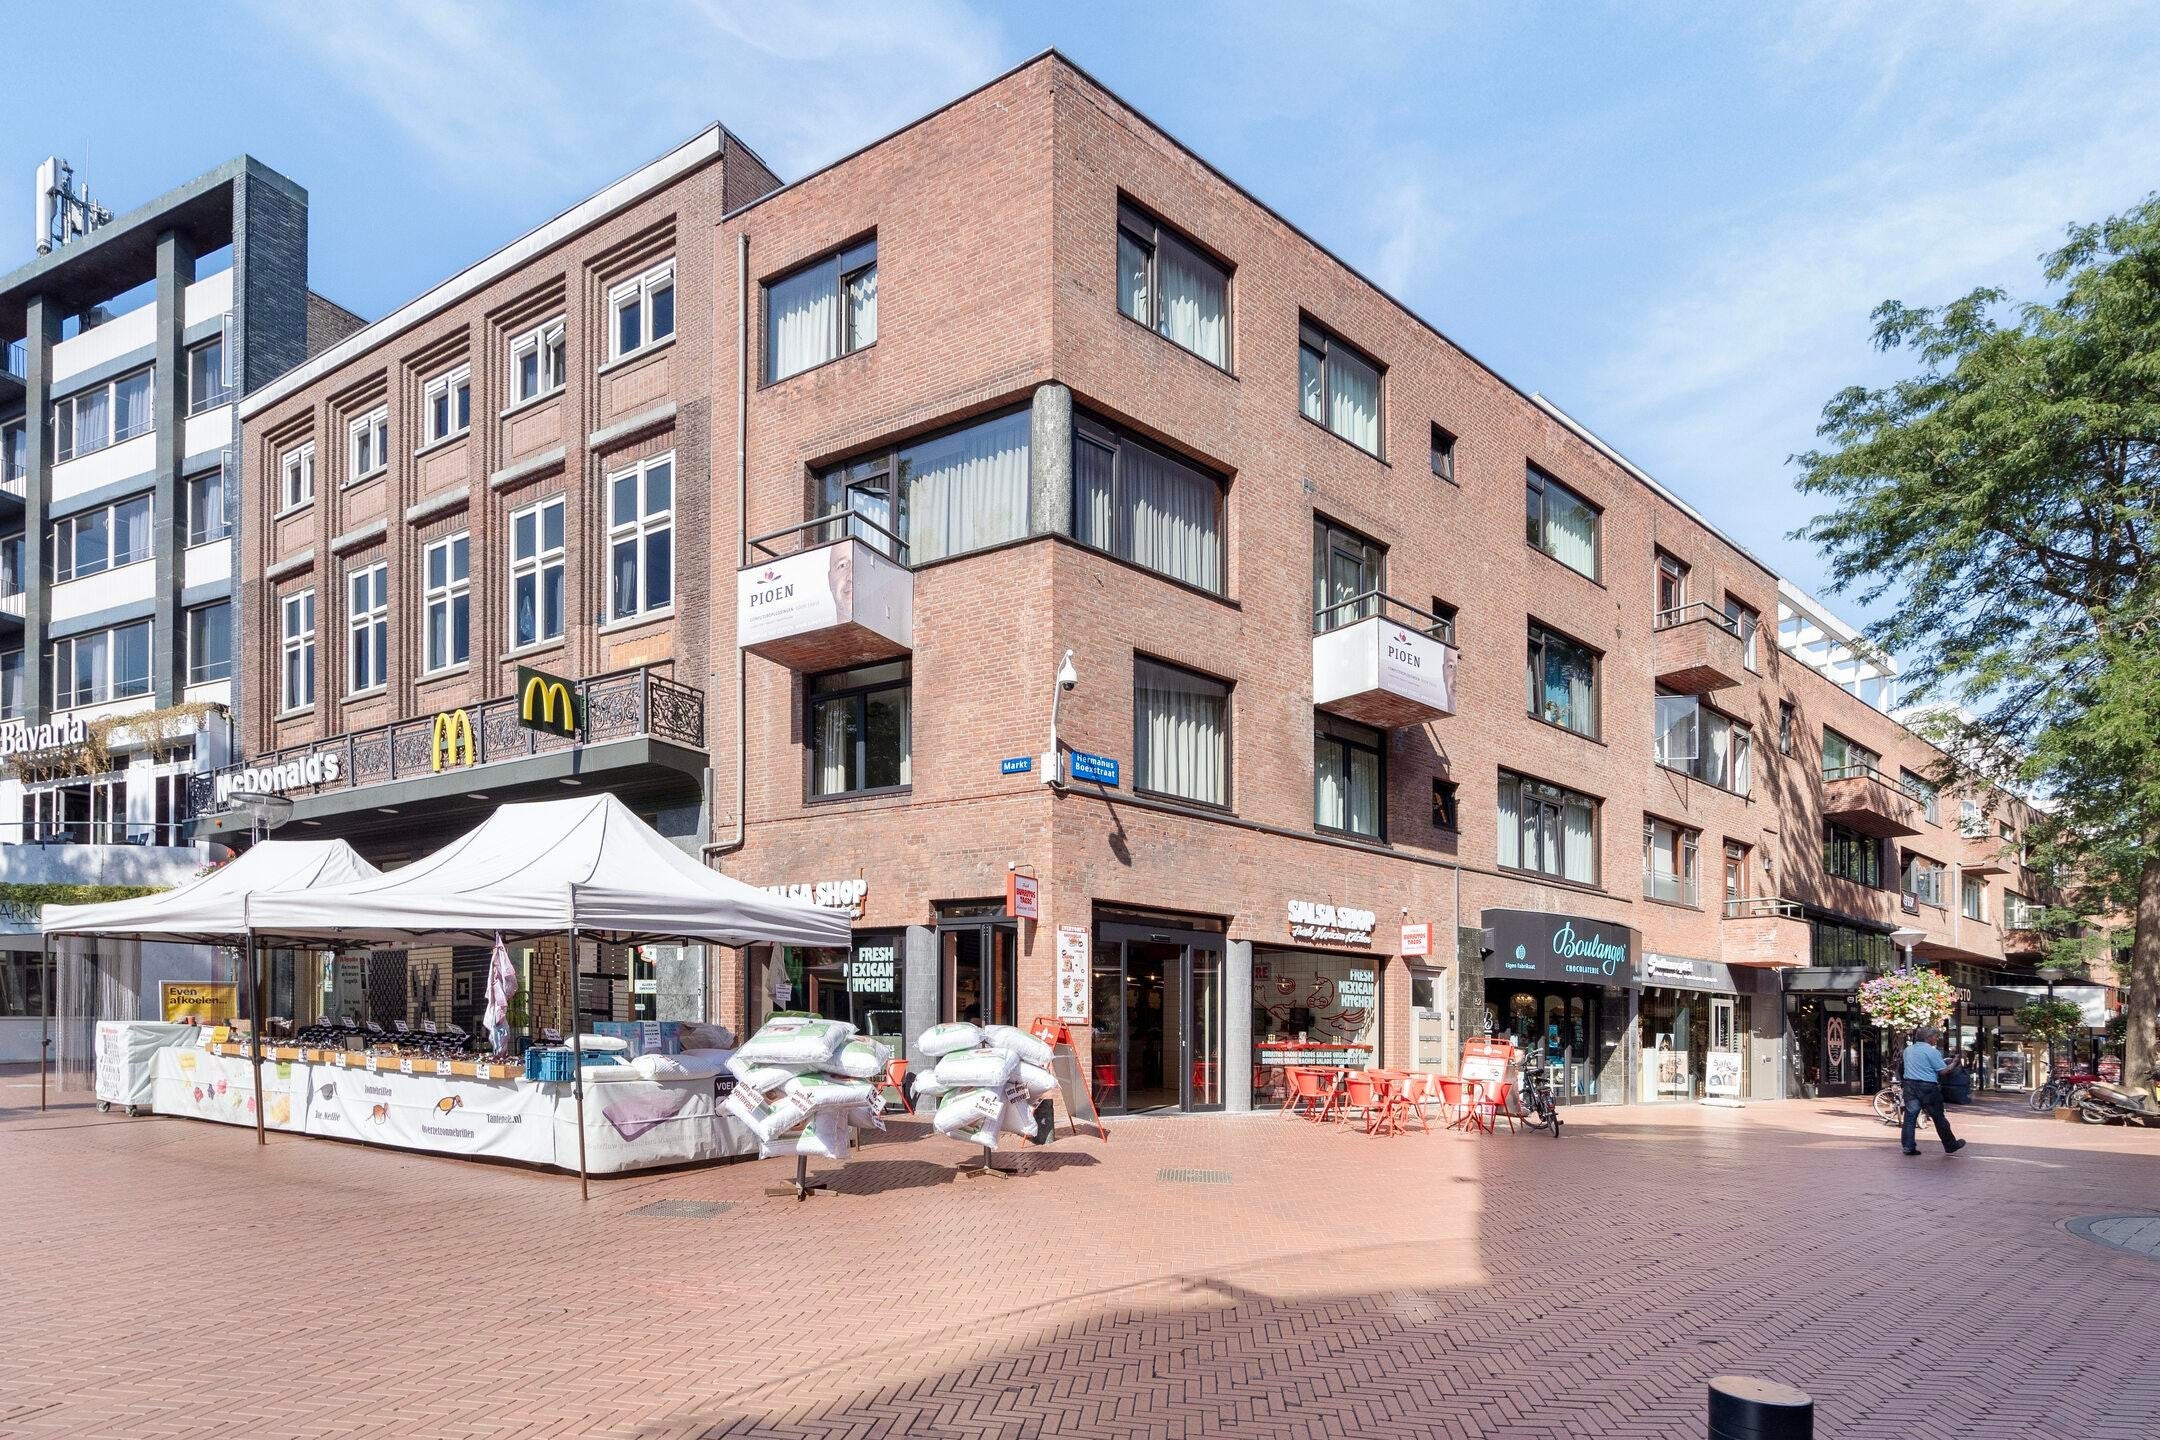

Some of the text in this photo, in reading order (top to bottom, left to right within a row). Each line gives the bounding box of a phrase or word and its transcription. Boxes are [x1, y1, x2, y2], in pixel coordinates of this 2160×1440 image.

[750, 584, 794, 607] PIOEN
[1388, 645, 1421, 668] PIOEN
[0, 713, 86, 756] Bavaria
[1003, 761, 1029, 771] Markt
[1076, 753, 1115, 769] Hermanus
[216, 753, 340, 803] McDonald's
[1075, 762, 1116, 778] Boexstraat
[815, 880, 868, 905] SHOP
[1288, 900, 1376, 932] SALSA SHOP
[859, 946, 894, 961] FRESH
[1553, 922, 1626, 975] Boulanger
[1350, 969, 1374, 981] FRESH
[1565, 965, 1600, 974] CHOCOLATERIE
[169, 987, 198, 996] Even
[1339, 980, 1374, 995] MEXICAN
[1341, 994, 1374, 1008] KITCHEN
[1713, 1059, 1732, 1067] Sale
